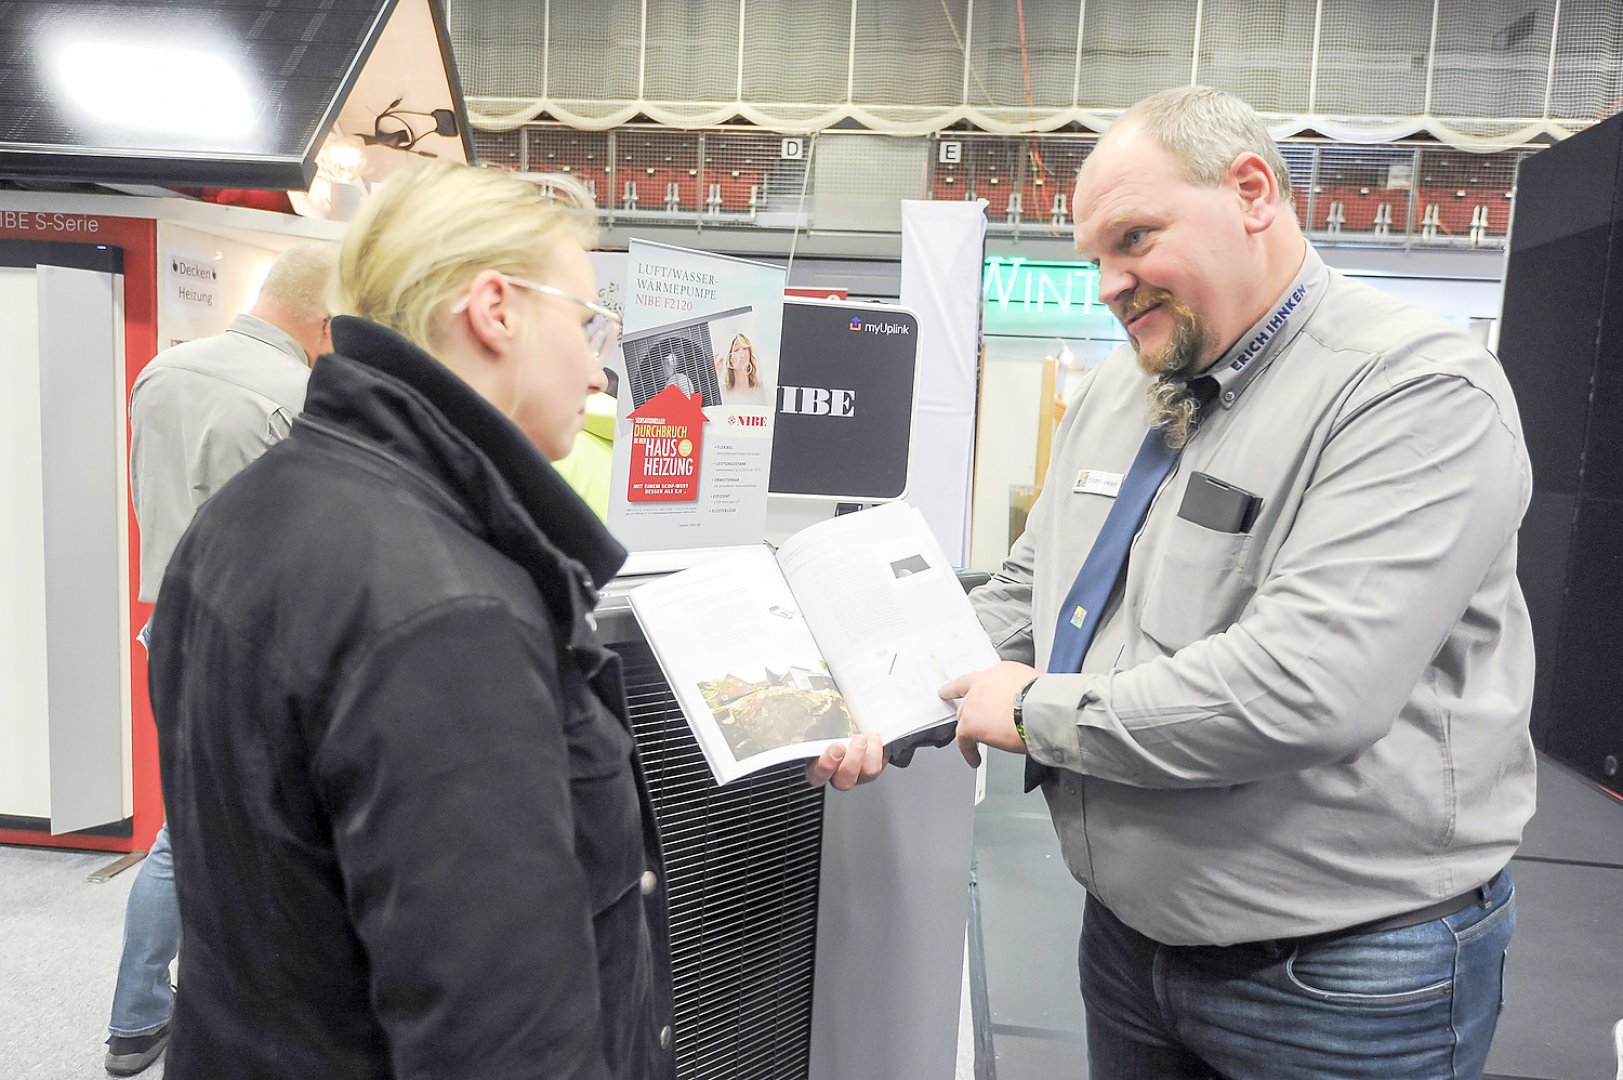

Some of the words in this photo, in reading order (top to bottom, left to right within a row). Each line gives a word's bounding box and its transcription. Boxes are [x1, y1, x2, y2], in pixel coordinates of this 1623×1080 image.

[787, 141, 799, 156] D
[945, 144, 957, 160] E
[35, 212, 99, 232] S-Serie
[179, 262, 211, 279] Decken
[637, 262, 719, 286] LUFT/WASSER-
[637, 277, 717, 300] WÄRMEPUMPE
[983, 256, 1115, 315] WINT
[179, 286, 212, 306] Heizung
[635, 293, 661, 307] NIBE
[664, 297, 693, 312] F2120
[864, 321, 910, 336] myUplink
[1230, 331, 1269, 371] ERICH
[1266, 284, 1307, 333] IHNKEN
[777, 385, 856, 418] IBE
[633, 424, 688, 438] DURCHBRUCH
[737, 415, 768, 428] NIBE
[645, 438, 678, 457] HAUS
[643, 458, 694, 476] HEIZUNG
